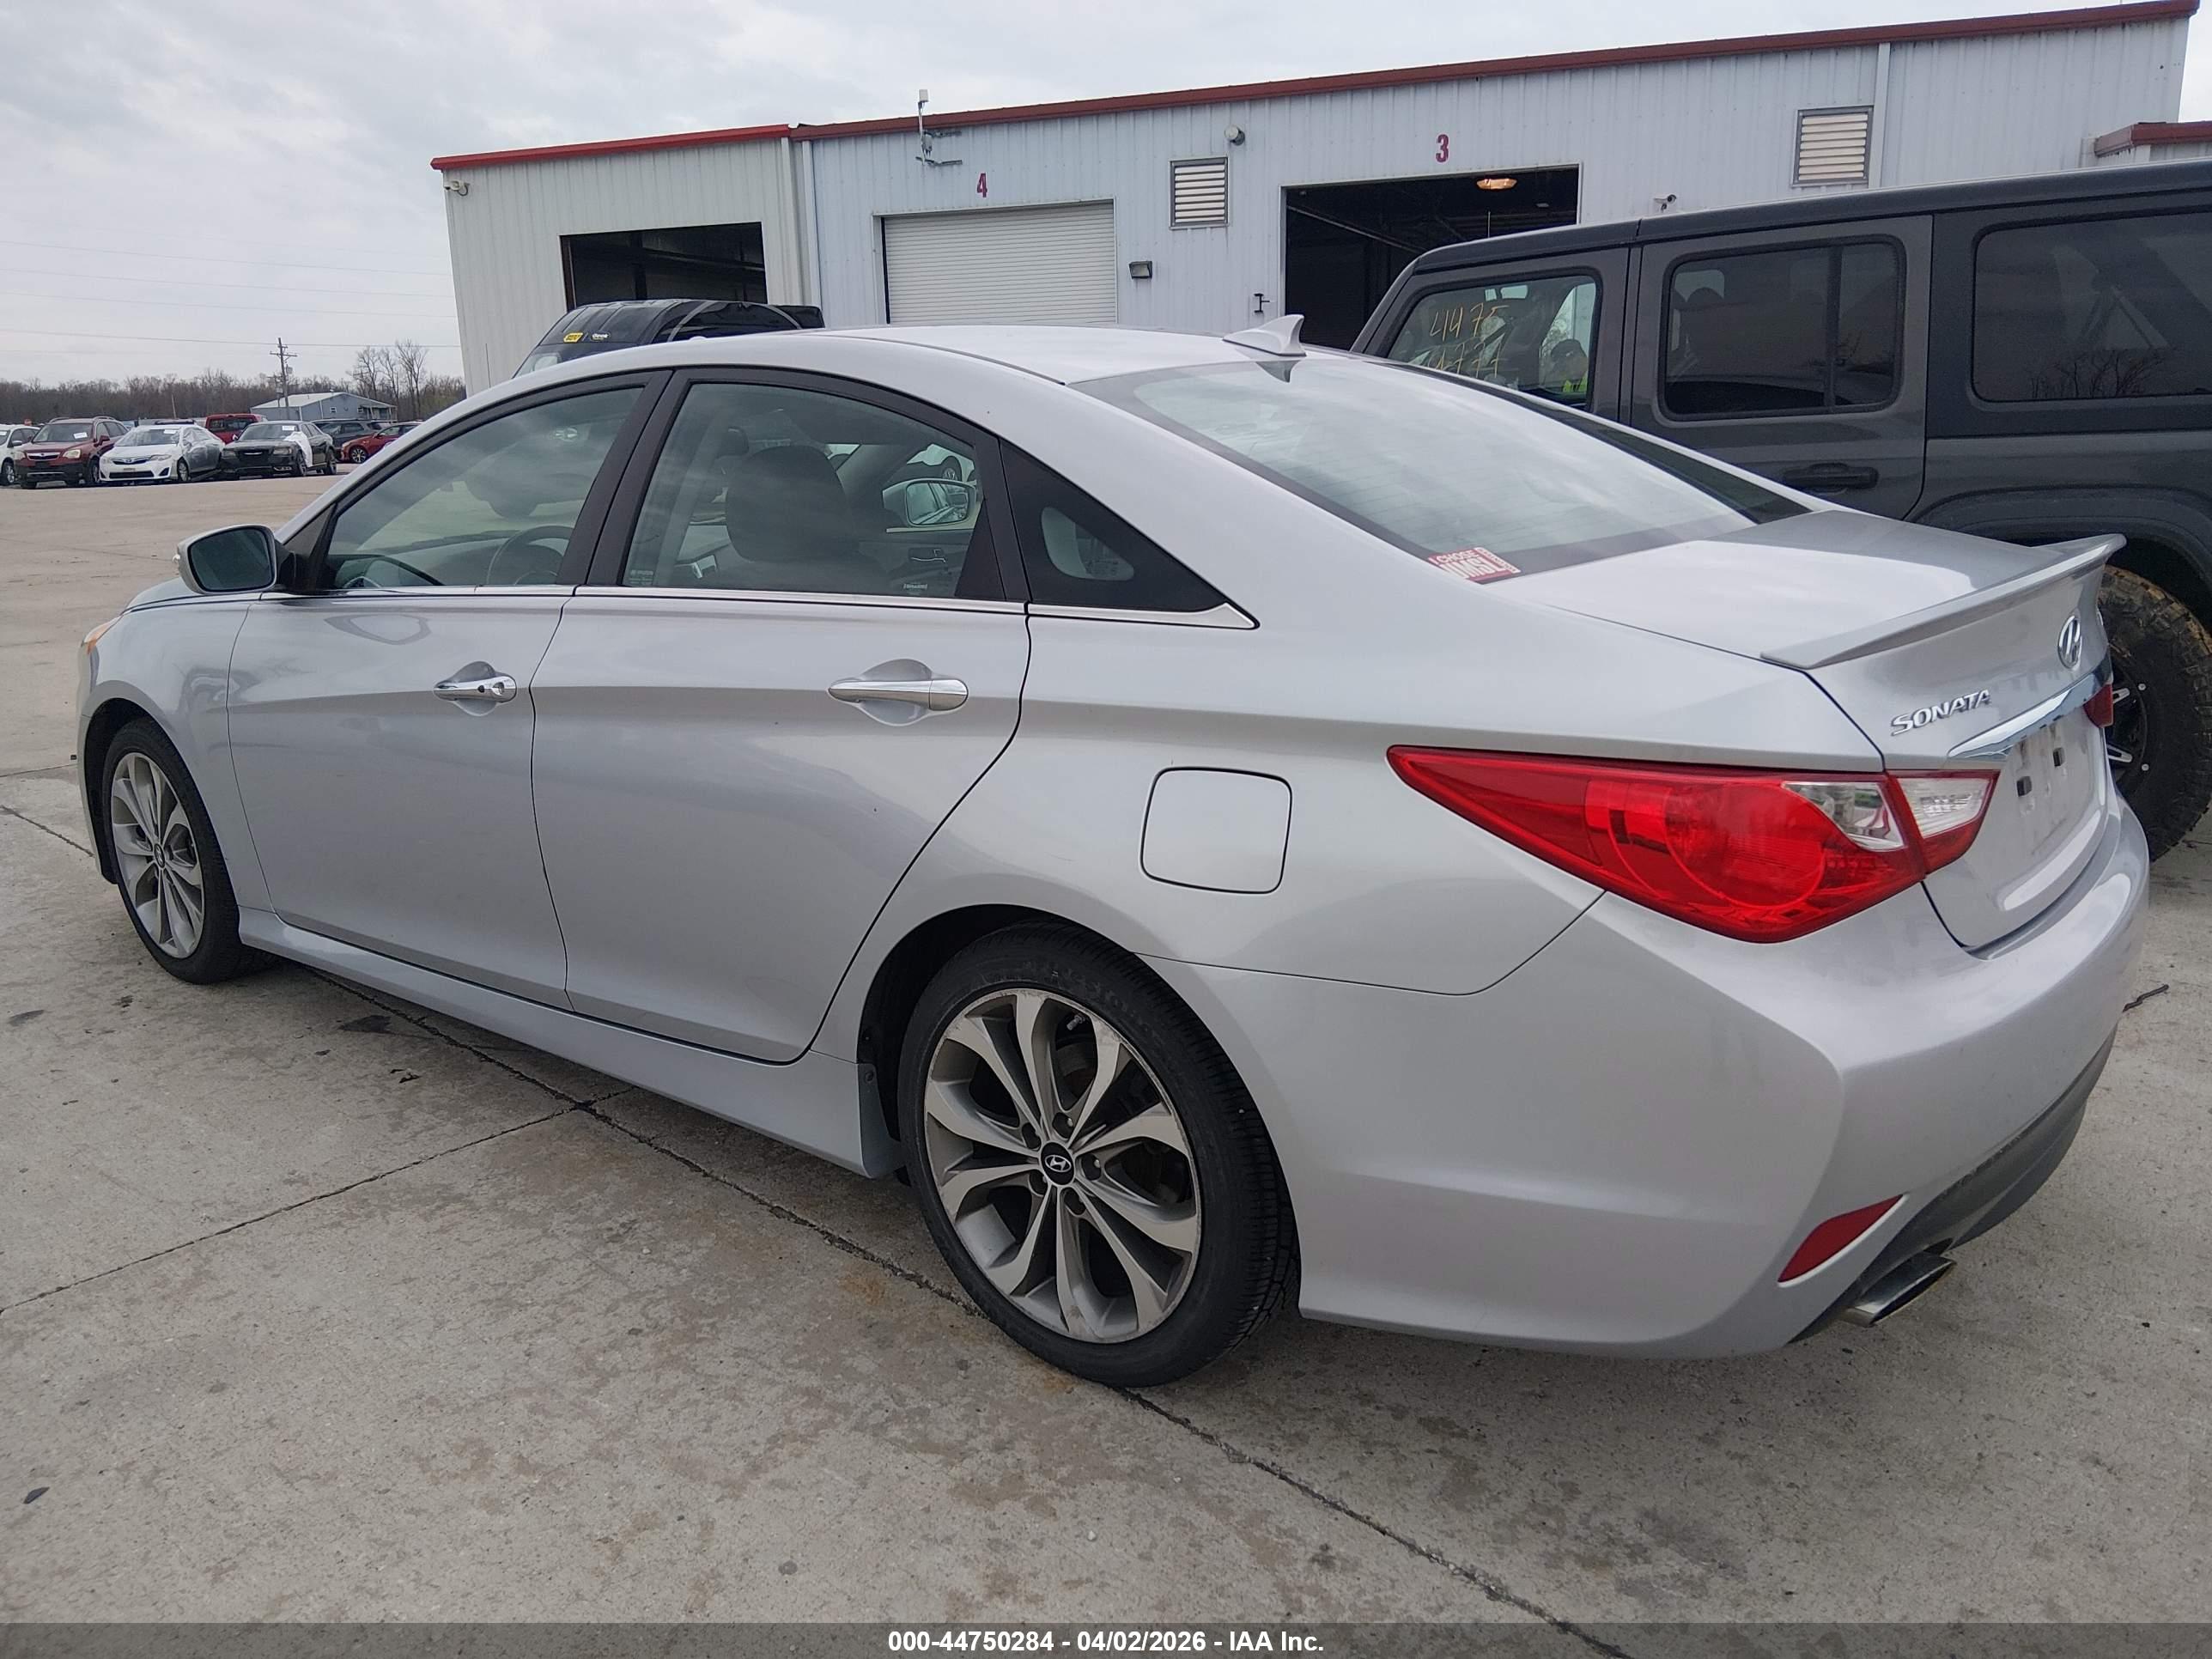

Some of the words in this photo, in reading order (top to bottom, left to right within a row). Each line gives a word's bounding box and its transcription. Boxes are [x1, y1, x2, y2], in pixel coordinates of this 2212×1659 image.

[1436, 134, 1449, 162] 3
[976, 173, 988, 198] 4
[1437, 550, 1480, 564] CHOSE
[1891, 689, 1990, 736] SONATA
